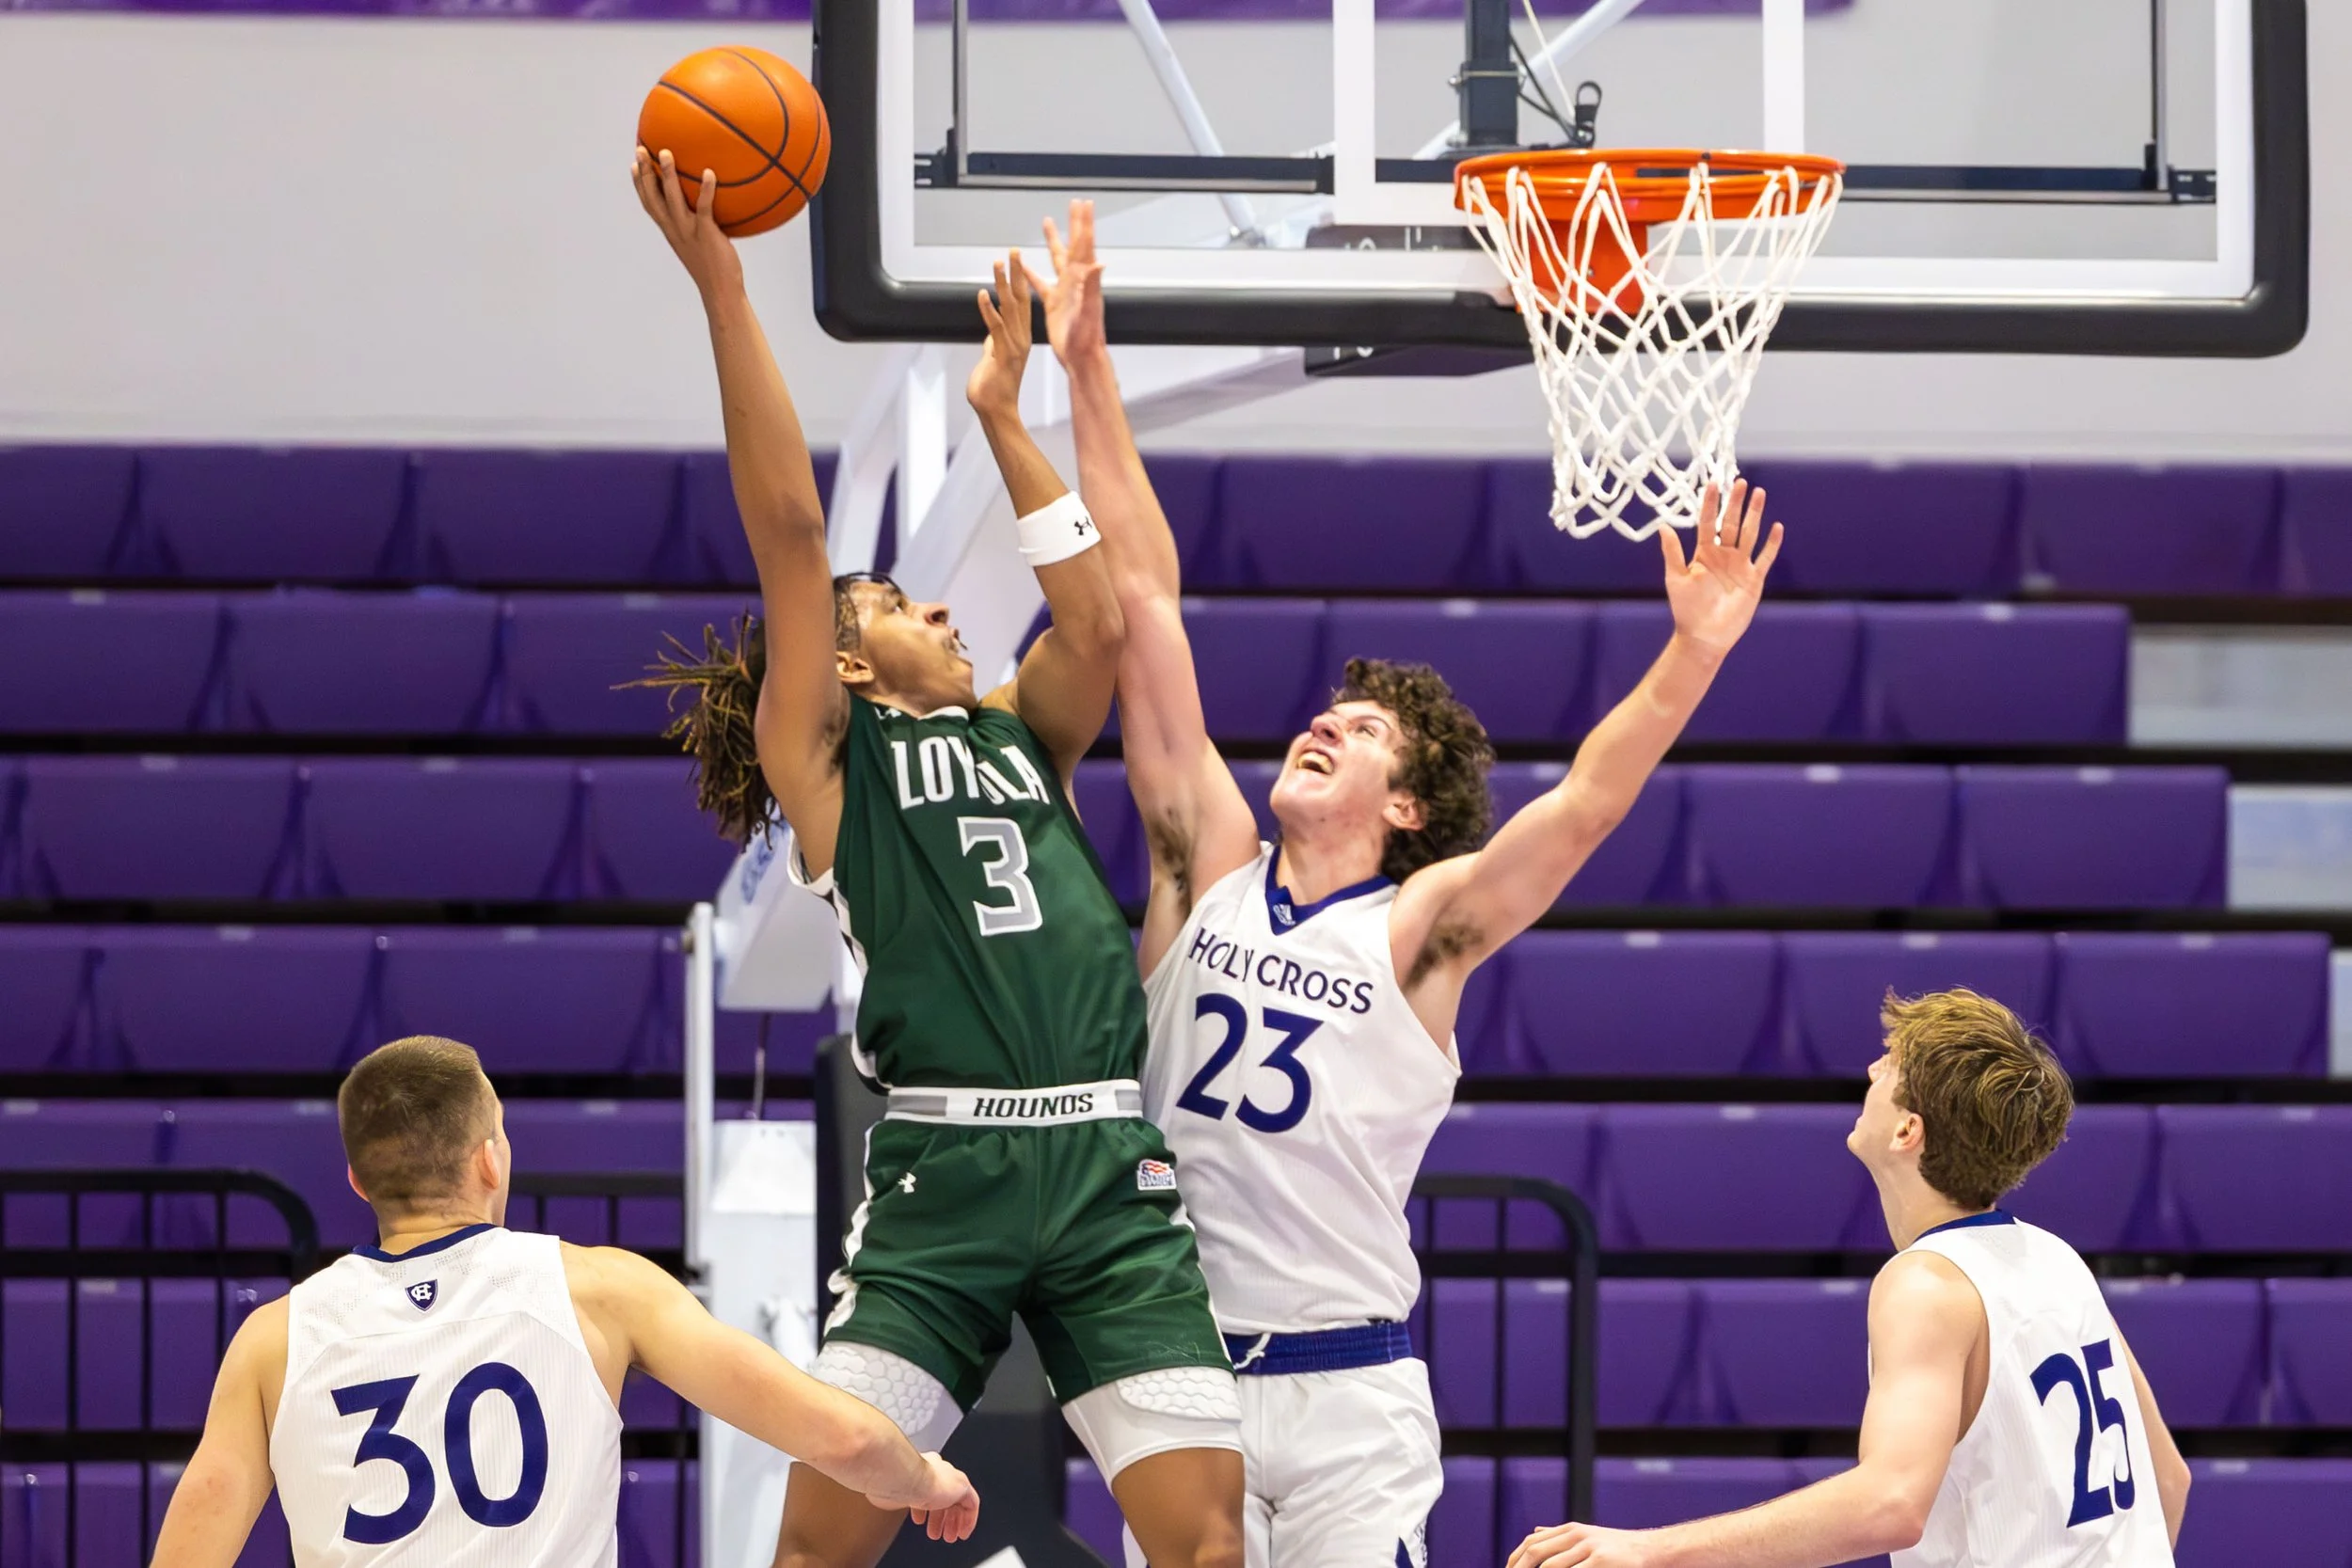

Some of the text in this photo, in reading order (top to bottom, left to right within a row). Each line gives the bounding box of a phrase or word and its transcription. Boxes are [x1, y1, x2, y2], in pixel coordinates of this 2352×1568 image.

[957, 816, 1043, 937] 3
[1188, 927, 1374, 1014] HOLY CROSS
[973, 1092, 1094, 1118] HOUNDS
[1176, 992, 1325, 1133] 23
[330, 1361, 548, 1544] 30
[2029, 1338, 2135, 1528] 25
